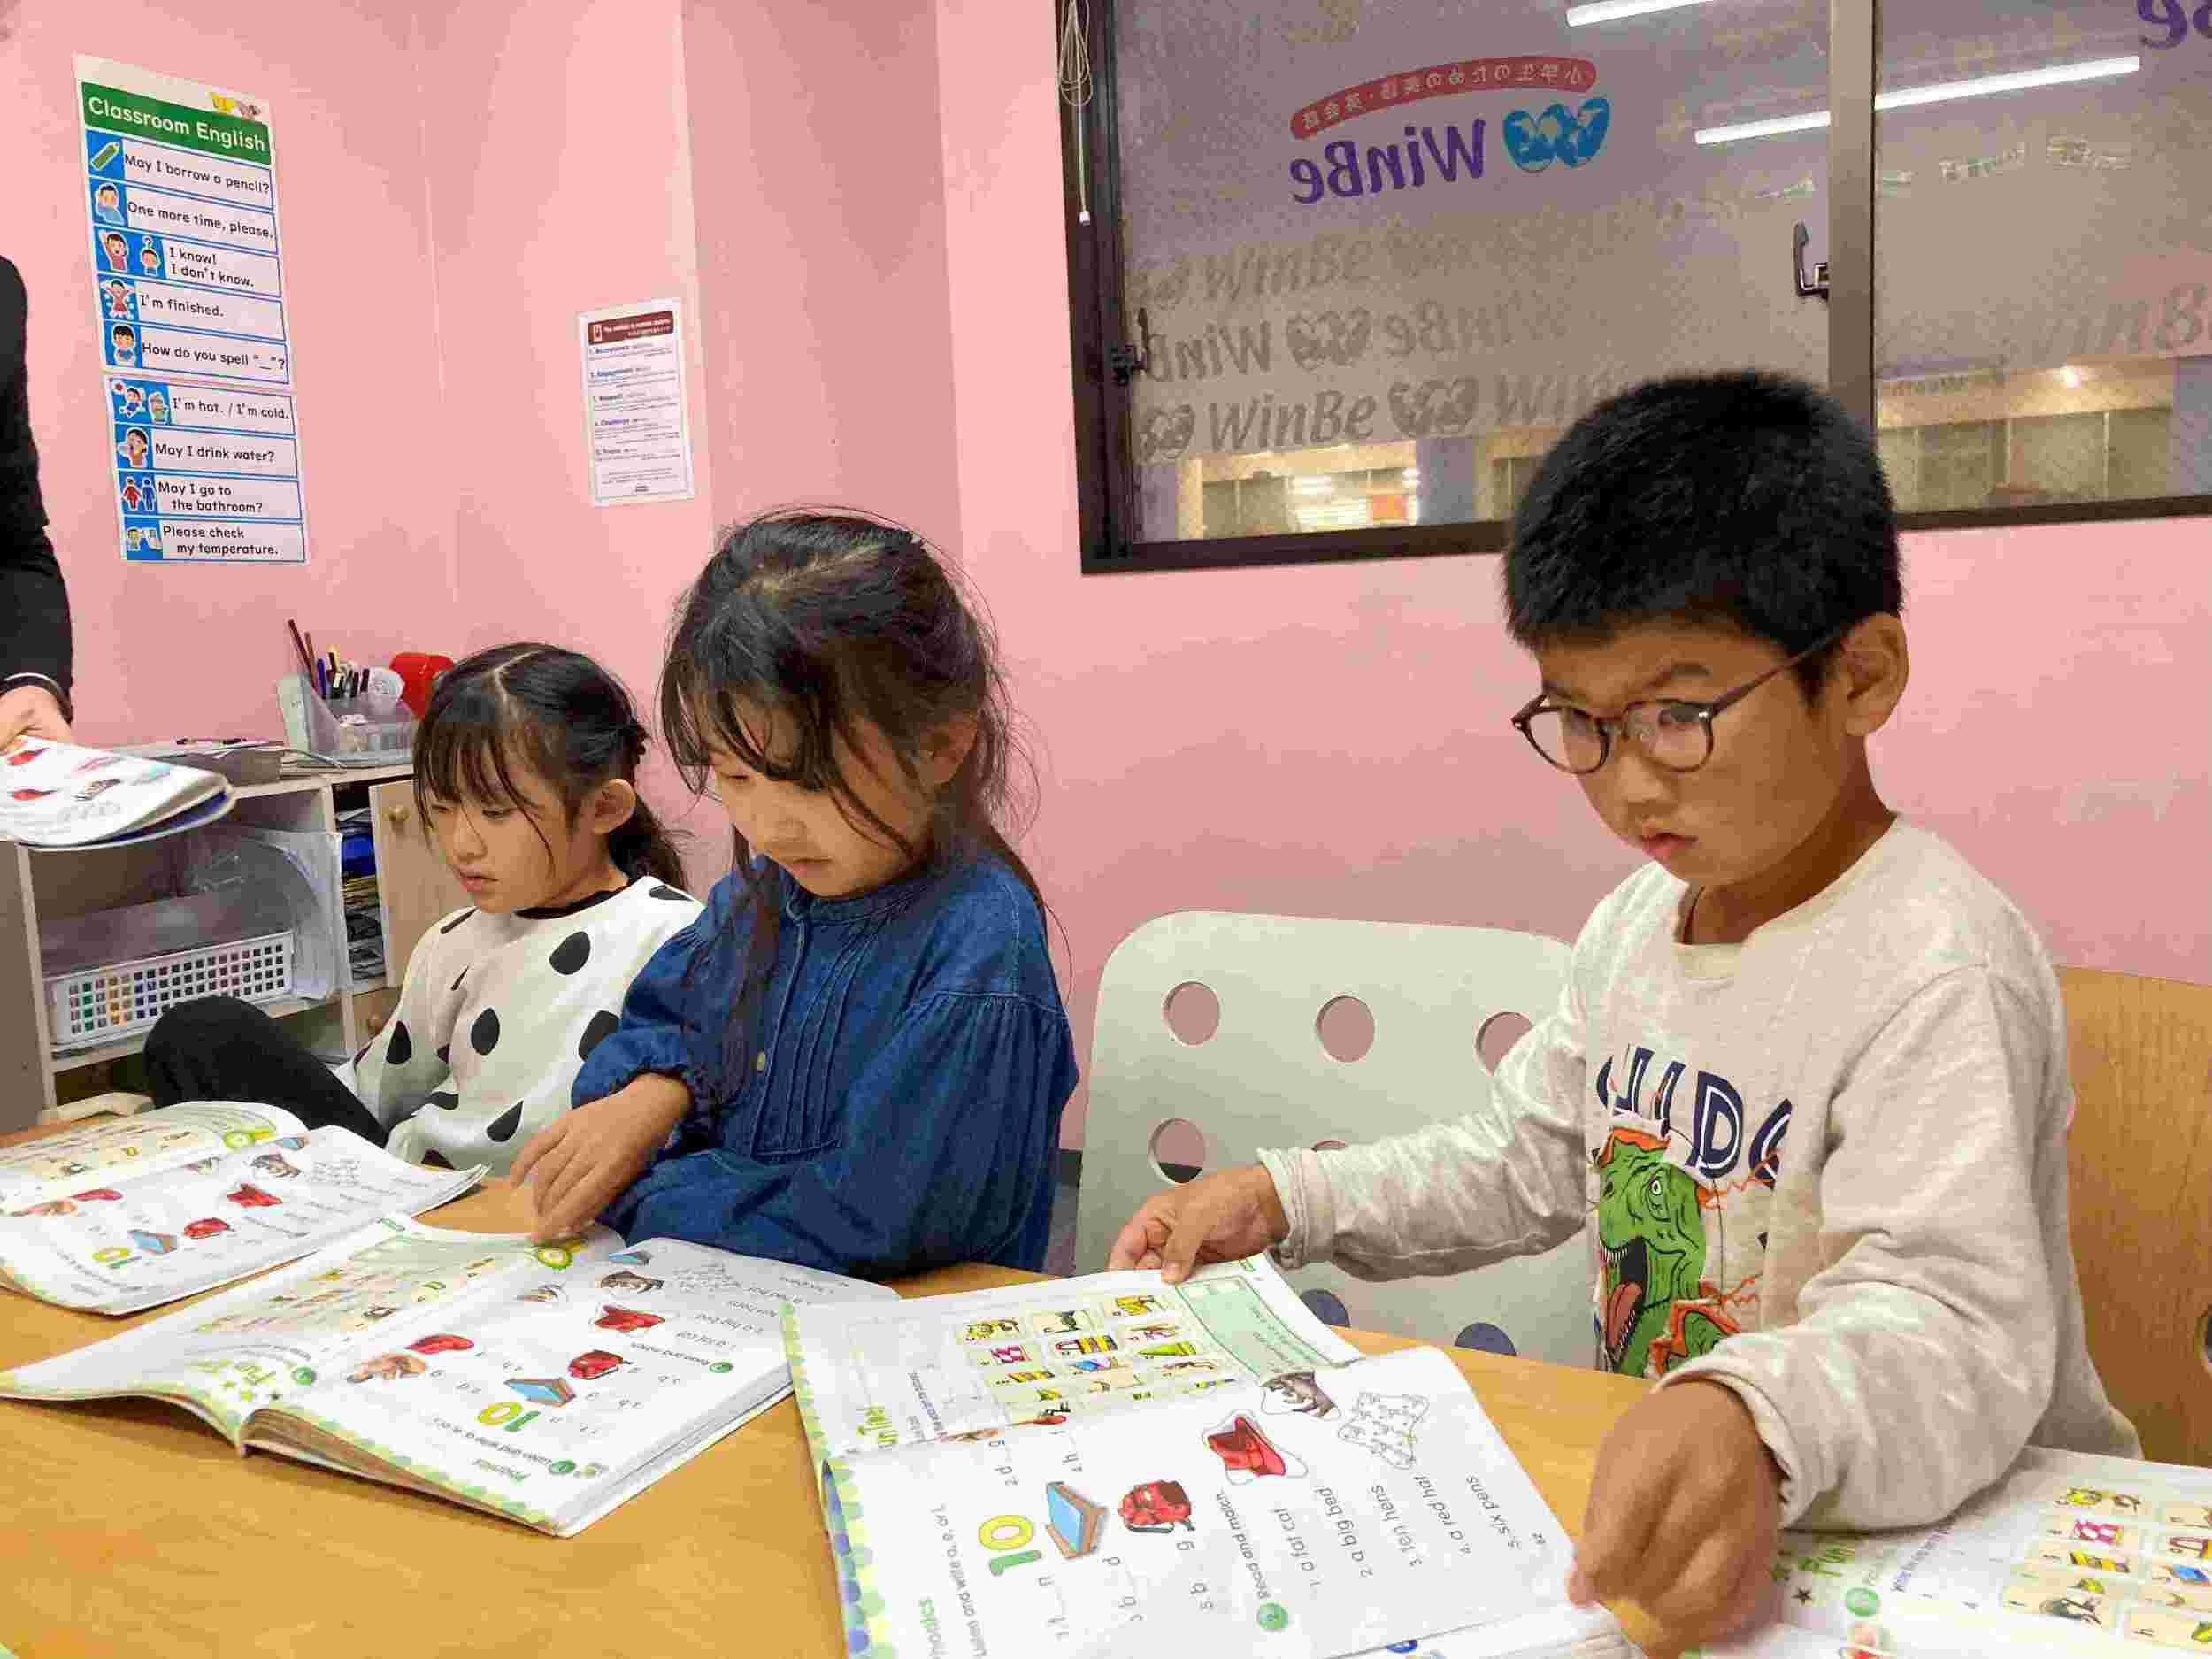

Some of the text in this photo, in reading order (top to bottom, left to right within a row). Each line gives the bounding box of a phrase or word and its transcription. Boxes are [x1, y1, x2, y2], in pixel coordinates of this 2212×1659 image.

[88, 96, 265, 152] Classroom English
[125, 154, 270, 195] May I borrow a pencil?
[127, 201, 274, 240] One more time, please.
[169, 246, 217, 265] I know!
[171, 263, 177, 274] I
[219, 268, 255, 288] know.
[140, 295, 224, 317] I'm finished.
[142, 342, 171, 356] How
[173, 347, 190, 358] do
[194, 350, 217, 362] you
[220, 351, 249, 367] spell
[173, 397, 196, 411] I'm
[199, 400, 224, 413] hot.
[237, 403, 257, 417] I'm
[261, 405, 288, 419] cold.
[1209, 390, 1377, 453] WinBe
[155, 443, 275, 463] May I drink water?
[158, 481, 232, 497] May I go to
[172, 498, 263, 513] the bathroom?
[163, 525, 245, 539] Please check
[177, 541, 279, 556] my temperature.
[1371, 1485, 1400, 1522] hens
[1336, 1519, 1357, 1547] big
[1449, 1531, 1463, 1540] a
[1232, 1533, 1253, 1559] and
[1286, 1535, 1310, 1557] fat
[1351, 1550, 1364, 1563] a
[1302, 1561, 1315, 1571] a
